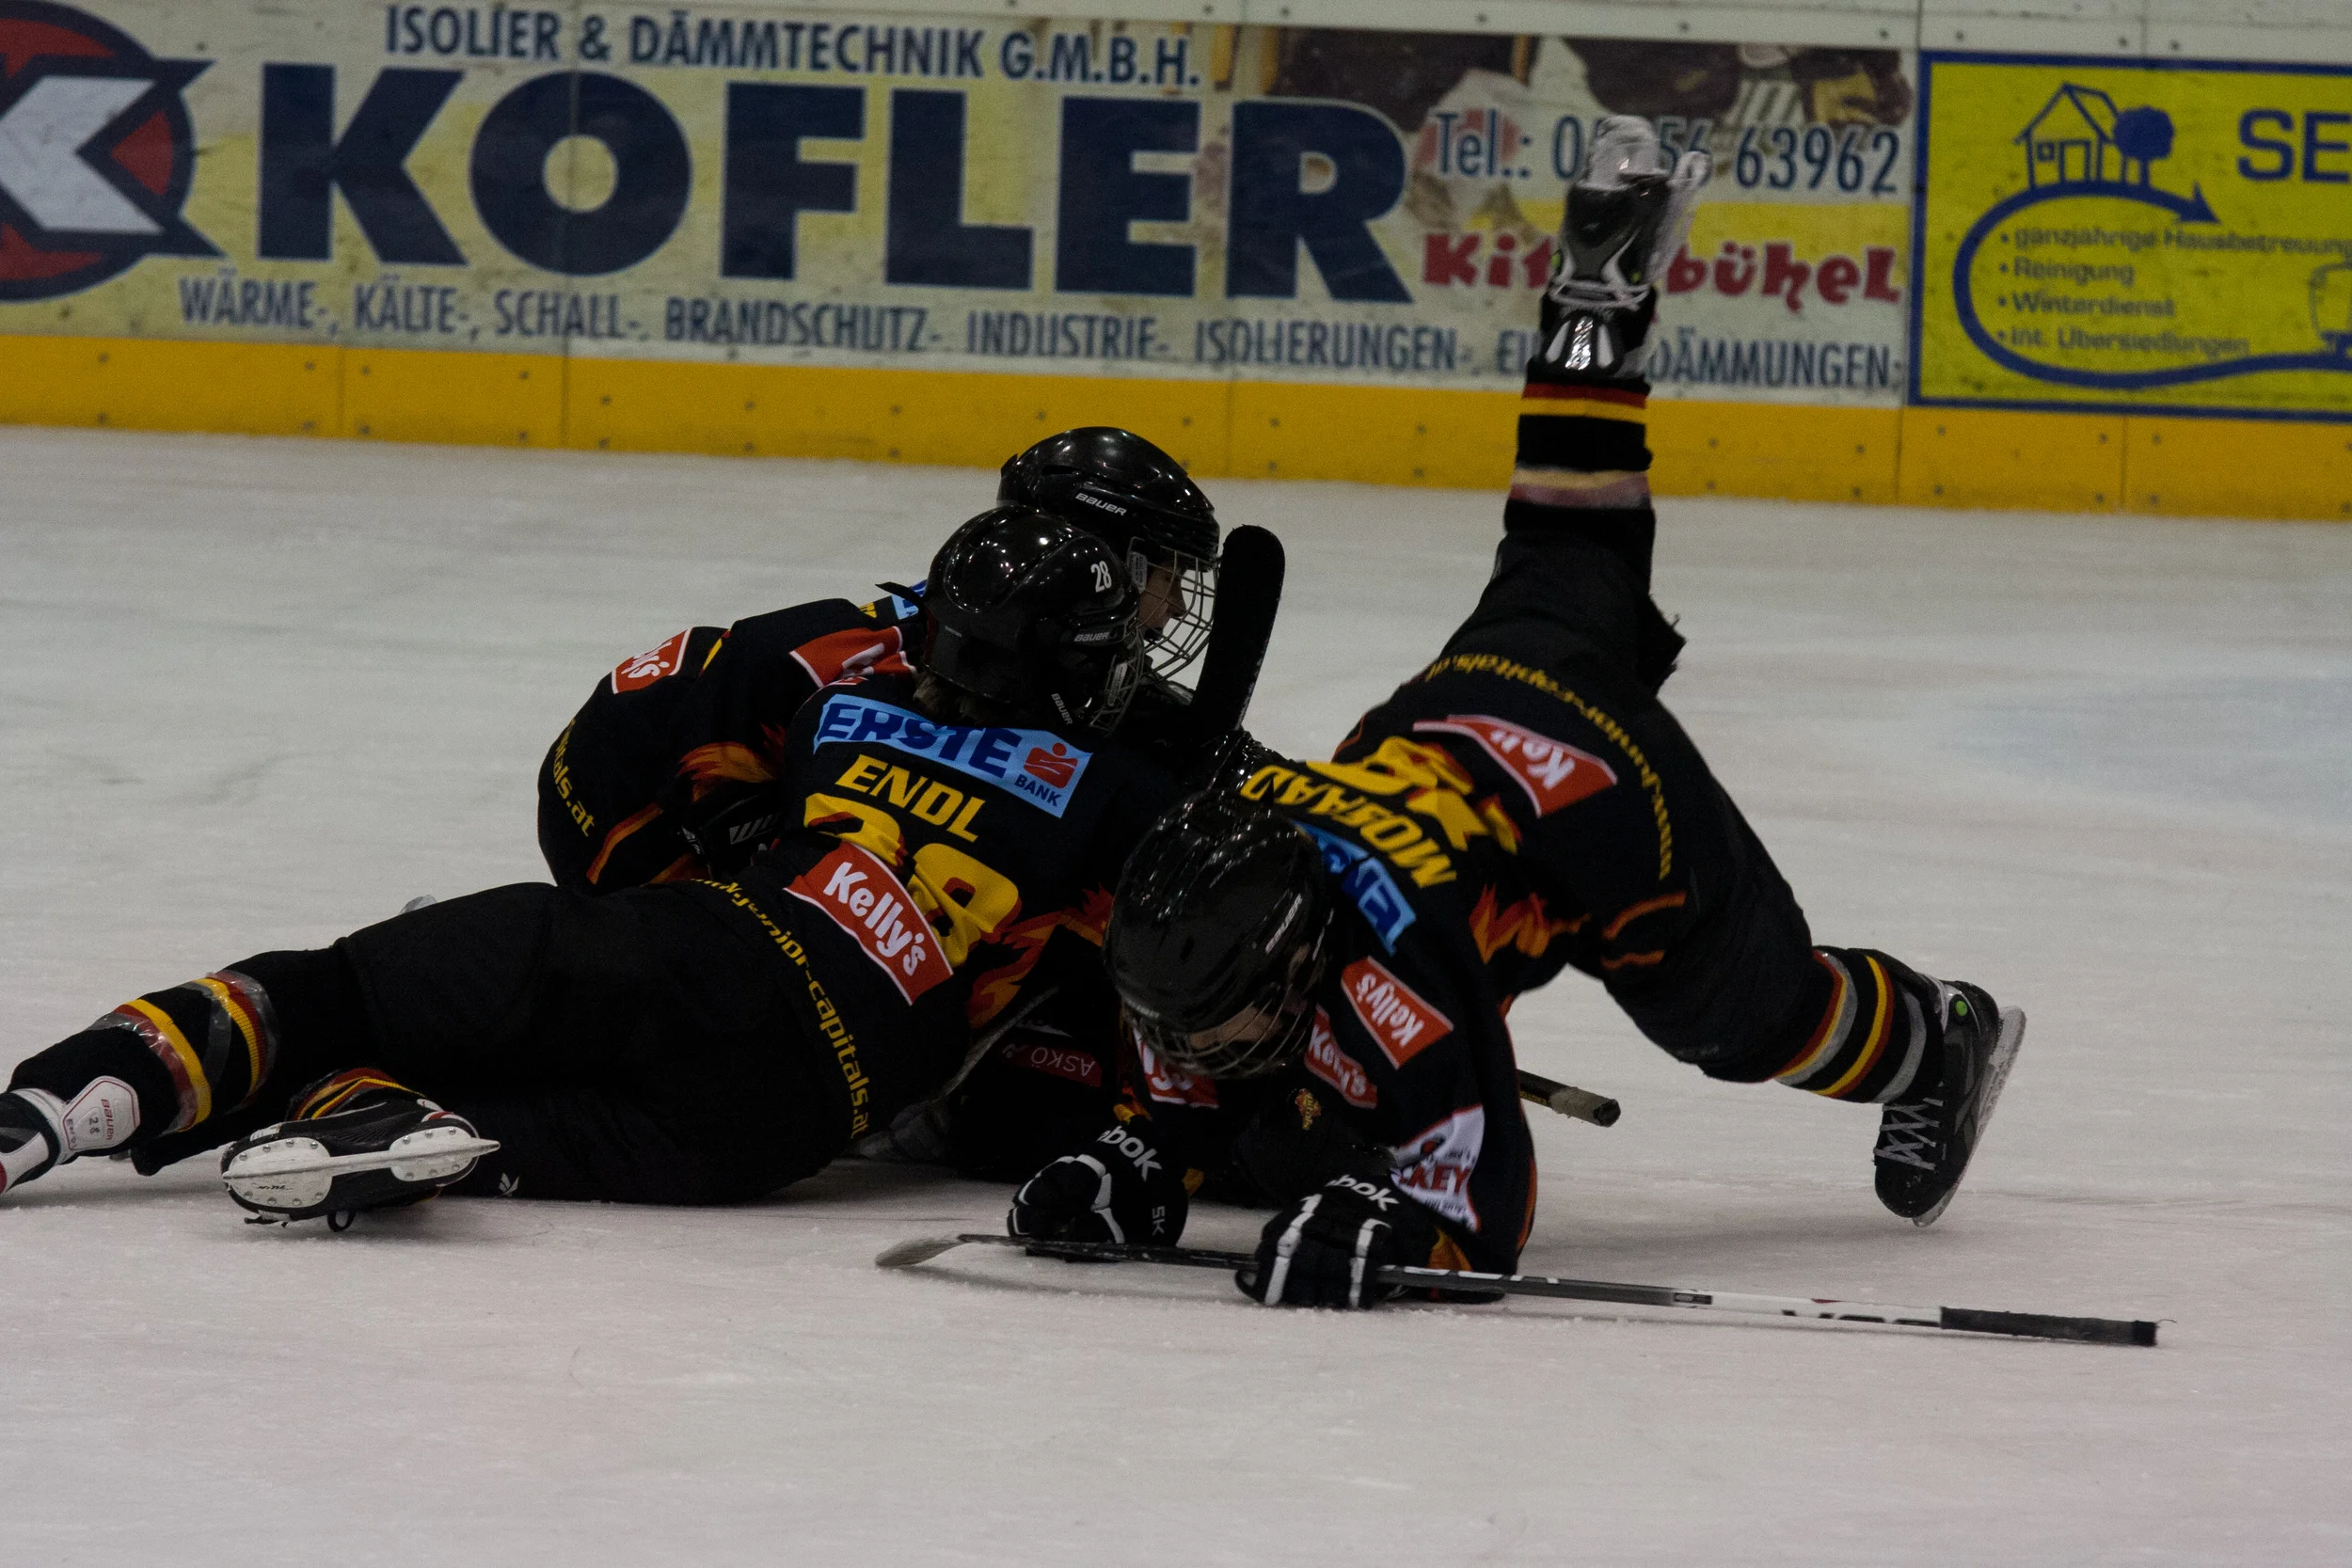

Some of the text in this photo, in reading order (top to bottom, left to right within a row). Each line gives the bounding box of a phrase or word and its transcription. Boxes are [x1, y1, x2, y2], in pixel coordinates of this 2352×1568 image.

[386, 6, 1200, 87] ISOLIER & DÄMMTECHNIK G.M.B.H.
[256, 62, 1414, 304] KOFLER
[1435, 109, 1532, 179] Tel.:
[1736, 124, 1900, 194] 63962
[1074, 492, 1128, 516] BAUER
[1089, 560, 1113, 594] 28
[818, 702, 1024, 780] ERSTE
[1050, 692, 1073, 725] BAUER
[834, 753, 986, 844] ENDL
[1013, 773, 1063, 807] BANK
[823, 861, 927, 977] Kelly's
[1356, 973, 1425, 1049] Kelly's
[1030, 1045, 1098, 1078] ASKÖ
